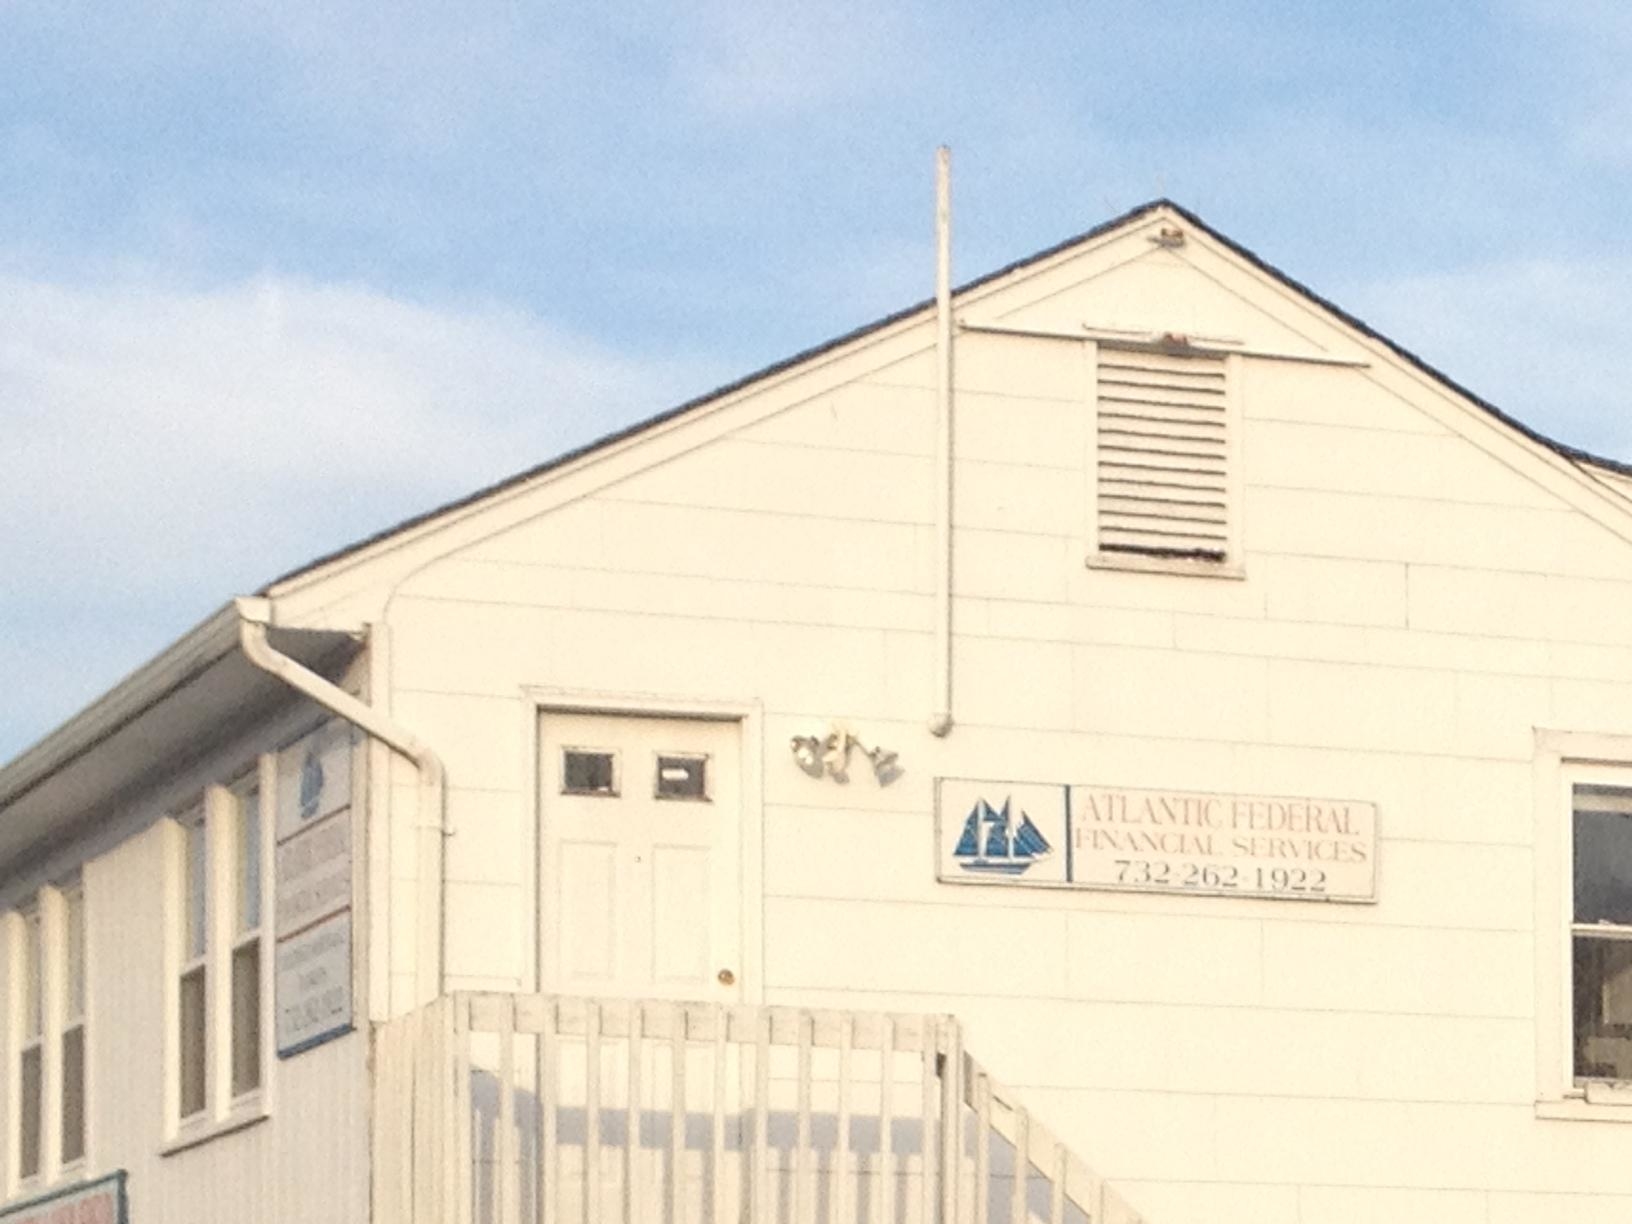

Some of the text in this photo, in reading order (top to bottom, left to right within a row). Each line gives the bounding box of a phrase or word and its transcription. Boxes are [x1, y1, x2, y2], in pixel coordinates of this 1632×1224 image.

[1081, 793, 1359, 835] ATLANTIC FEDERAL
[1074, 827, 1366, 863] FINANCIAL SERVICES
[1115, 860, 1327, 891] 732-262-1922
